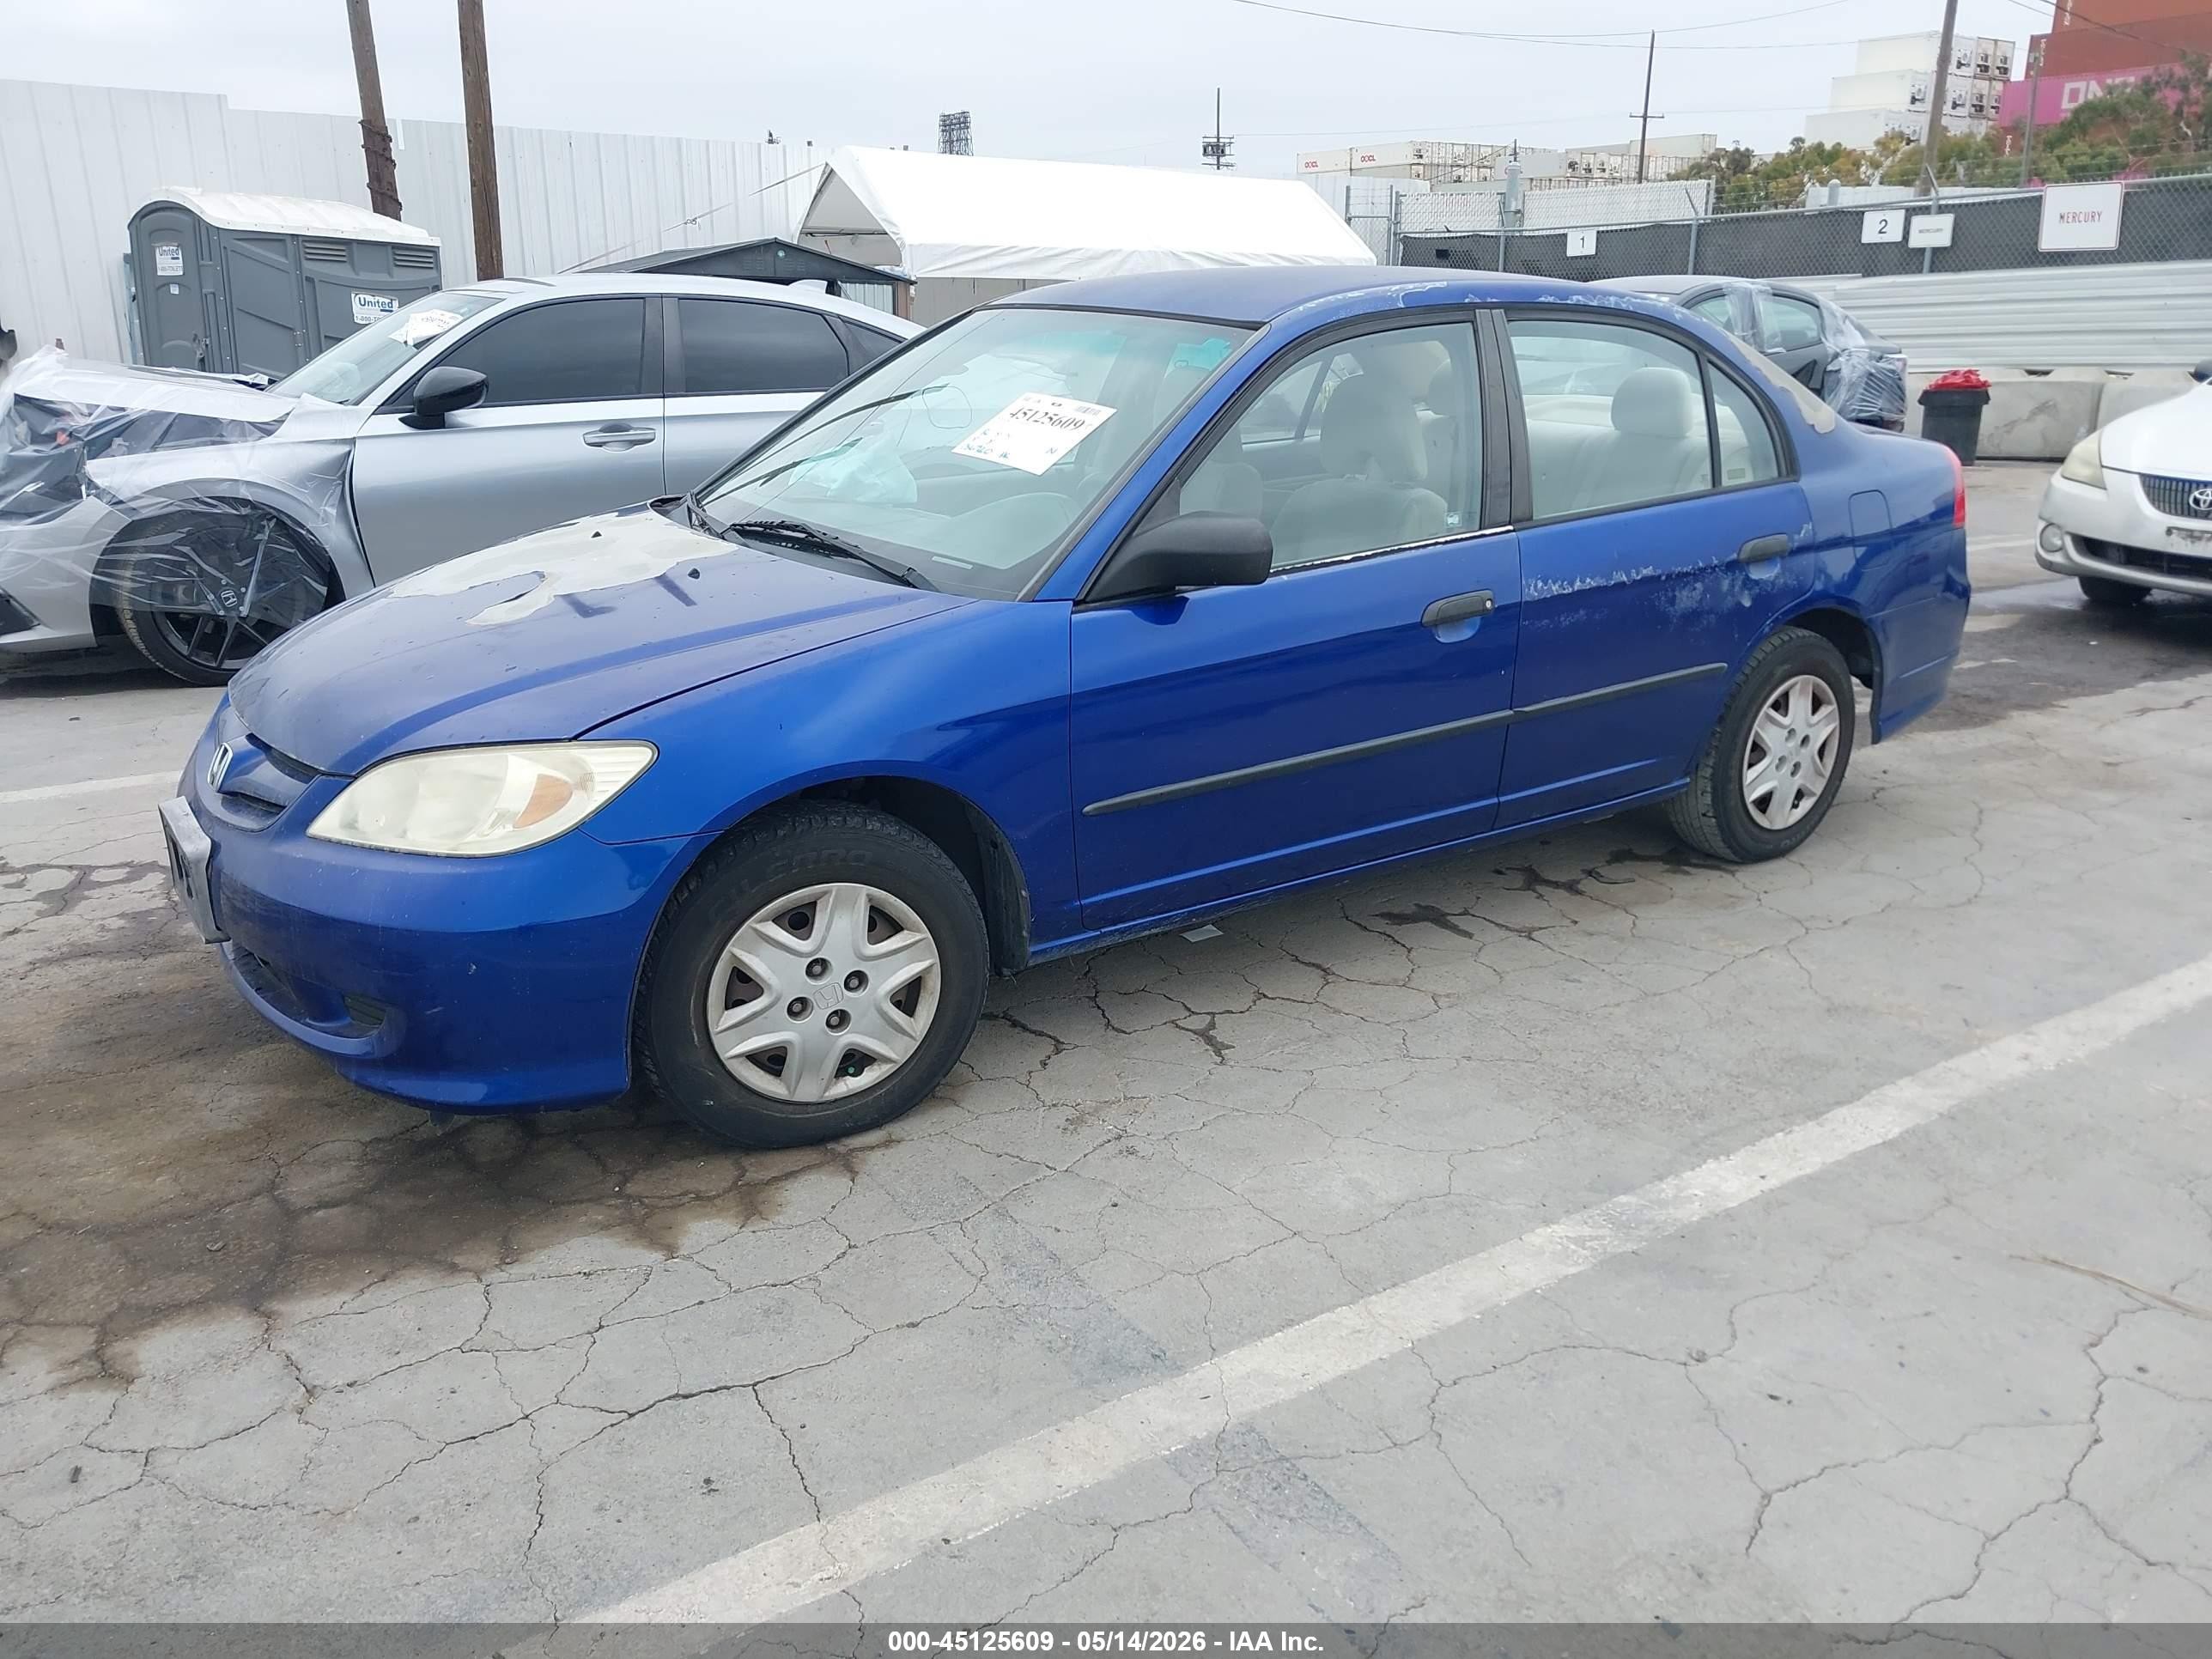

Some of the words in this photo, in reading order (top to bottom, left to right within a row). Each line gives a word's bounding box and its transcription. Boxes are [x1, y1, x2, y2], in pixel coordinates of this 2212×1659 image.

[2059, 210, 2103, 224] MERCURY
[1878, 219, 1888, 234] 2
[1579, 235, 1585, 248] 1
[158, 246, 179, 257] United
[358, 296, 393, 309] United
[1009, 407, 1085, 430] 45125609
